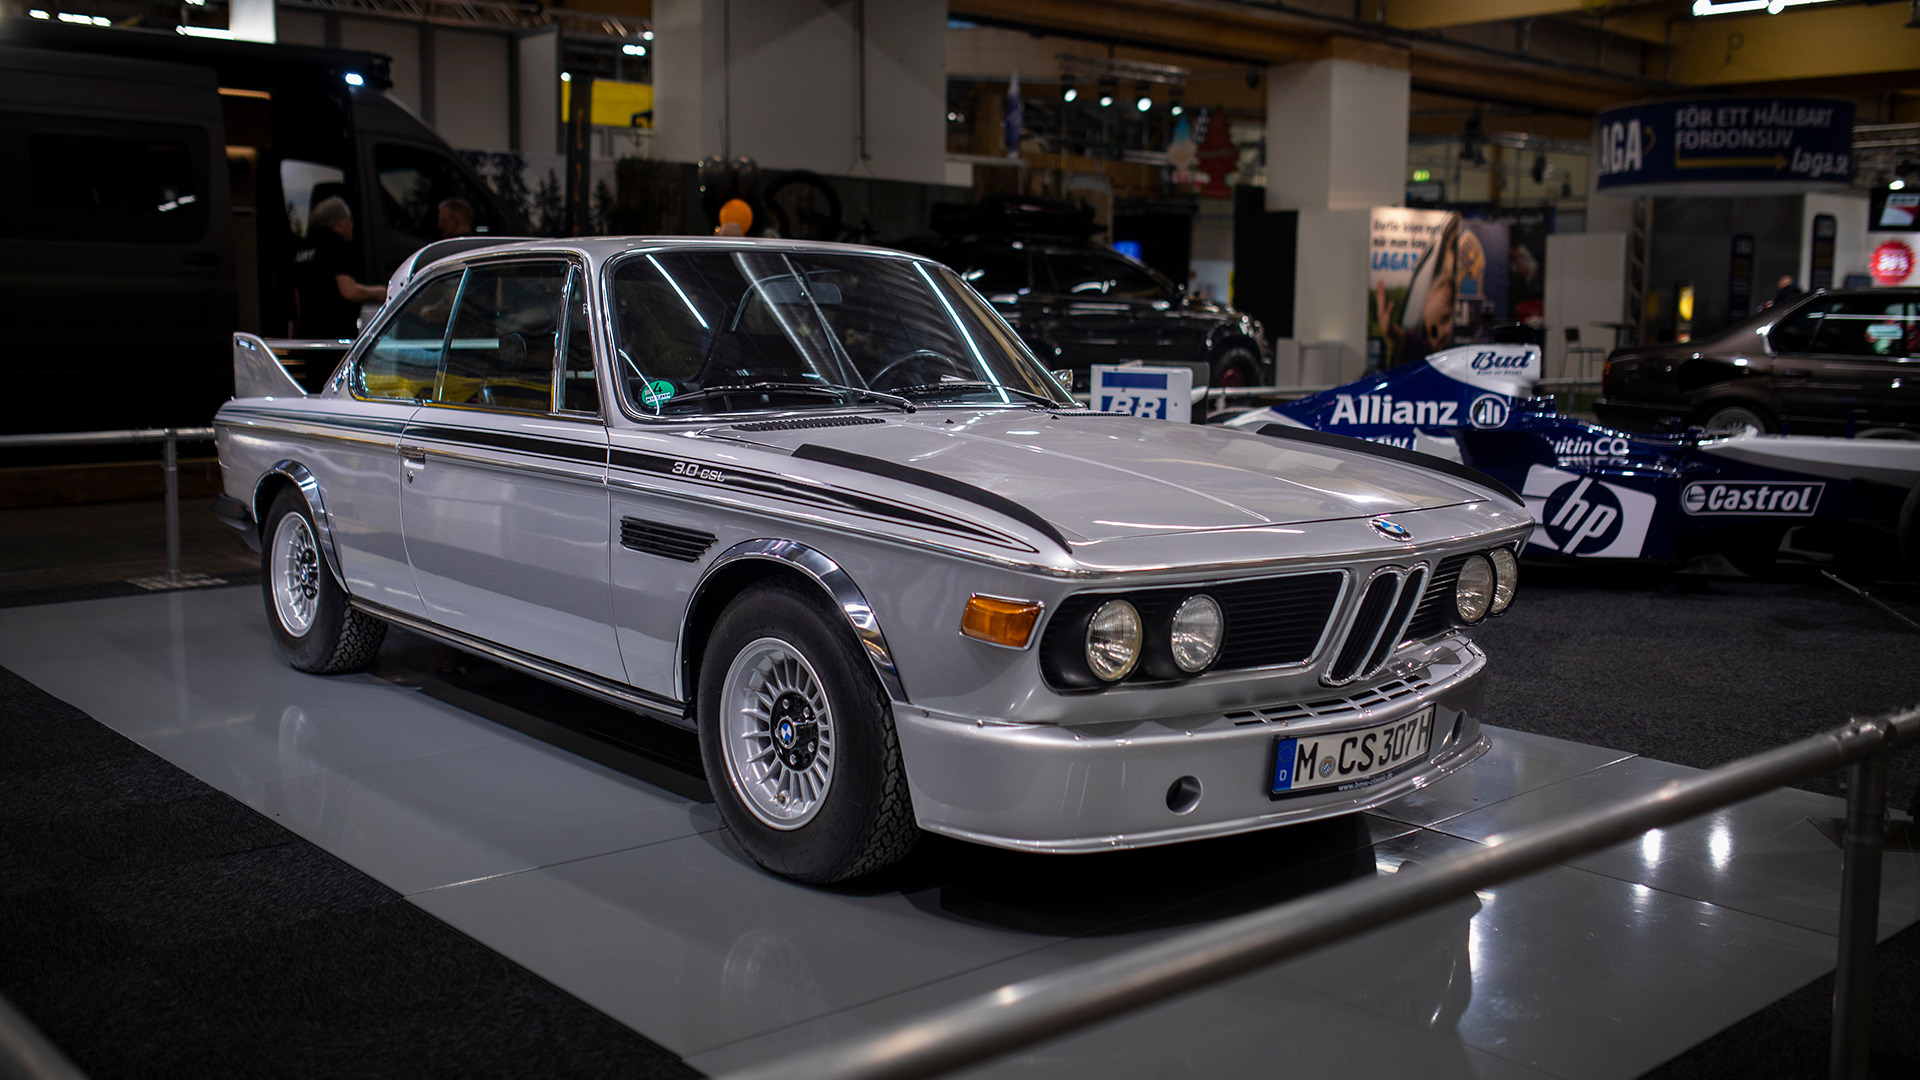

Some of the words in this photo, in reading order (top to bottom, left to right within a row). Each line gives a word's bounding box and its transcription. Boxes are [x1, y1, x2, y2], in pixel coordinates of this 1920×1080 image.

[1675, 103, 1712, 128] FÖR
[1716, 106, 1750, 127] ETT
[1752, 101, 1834, 128] HÅLLBART
[1675, 129, 1796, 150] FORDONSLIV
[1471, 351, 1533, 370] Bud
[653, 382, 663, 393] 4
[1329, 394, 1459, 426] Allianz
[672, 461, 700, 477] 3.0
[700, 468, 725, 482] CSL
[1708, 484, 1813, 512] Castrol
[1550, 476, 1618, 554] hp
[1294, 741, 1318, 782] M
[1338, 733, 1377, 775] CS
[1378, 711, 1432, 766] 307H
[1279, 769, 1288, 782] D
